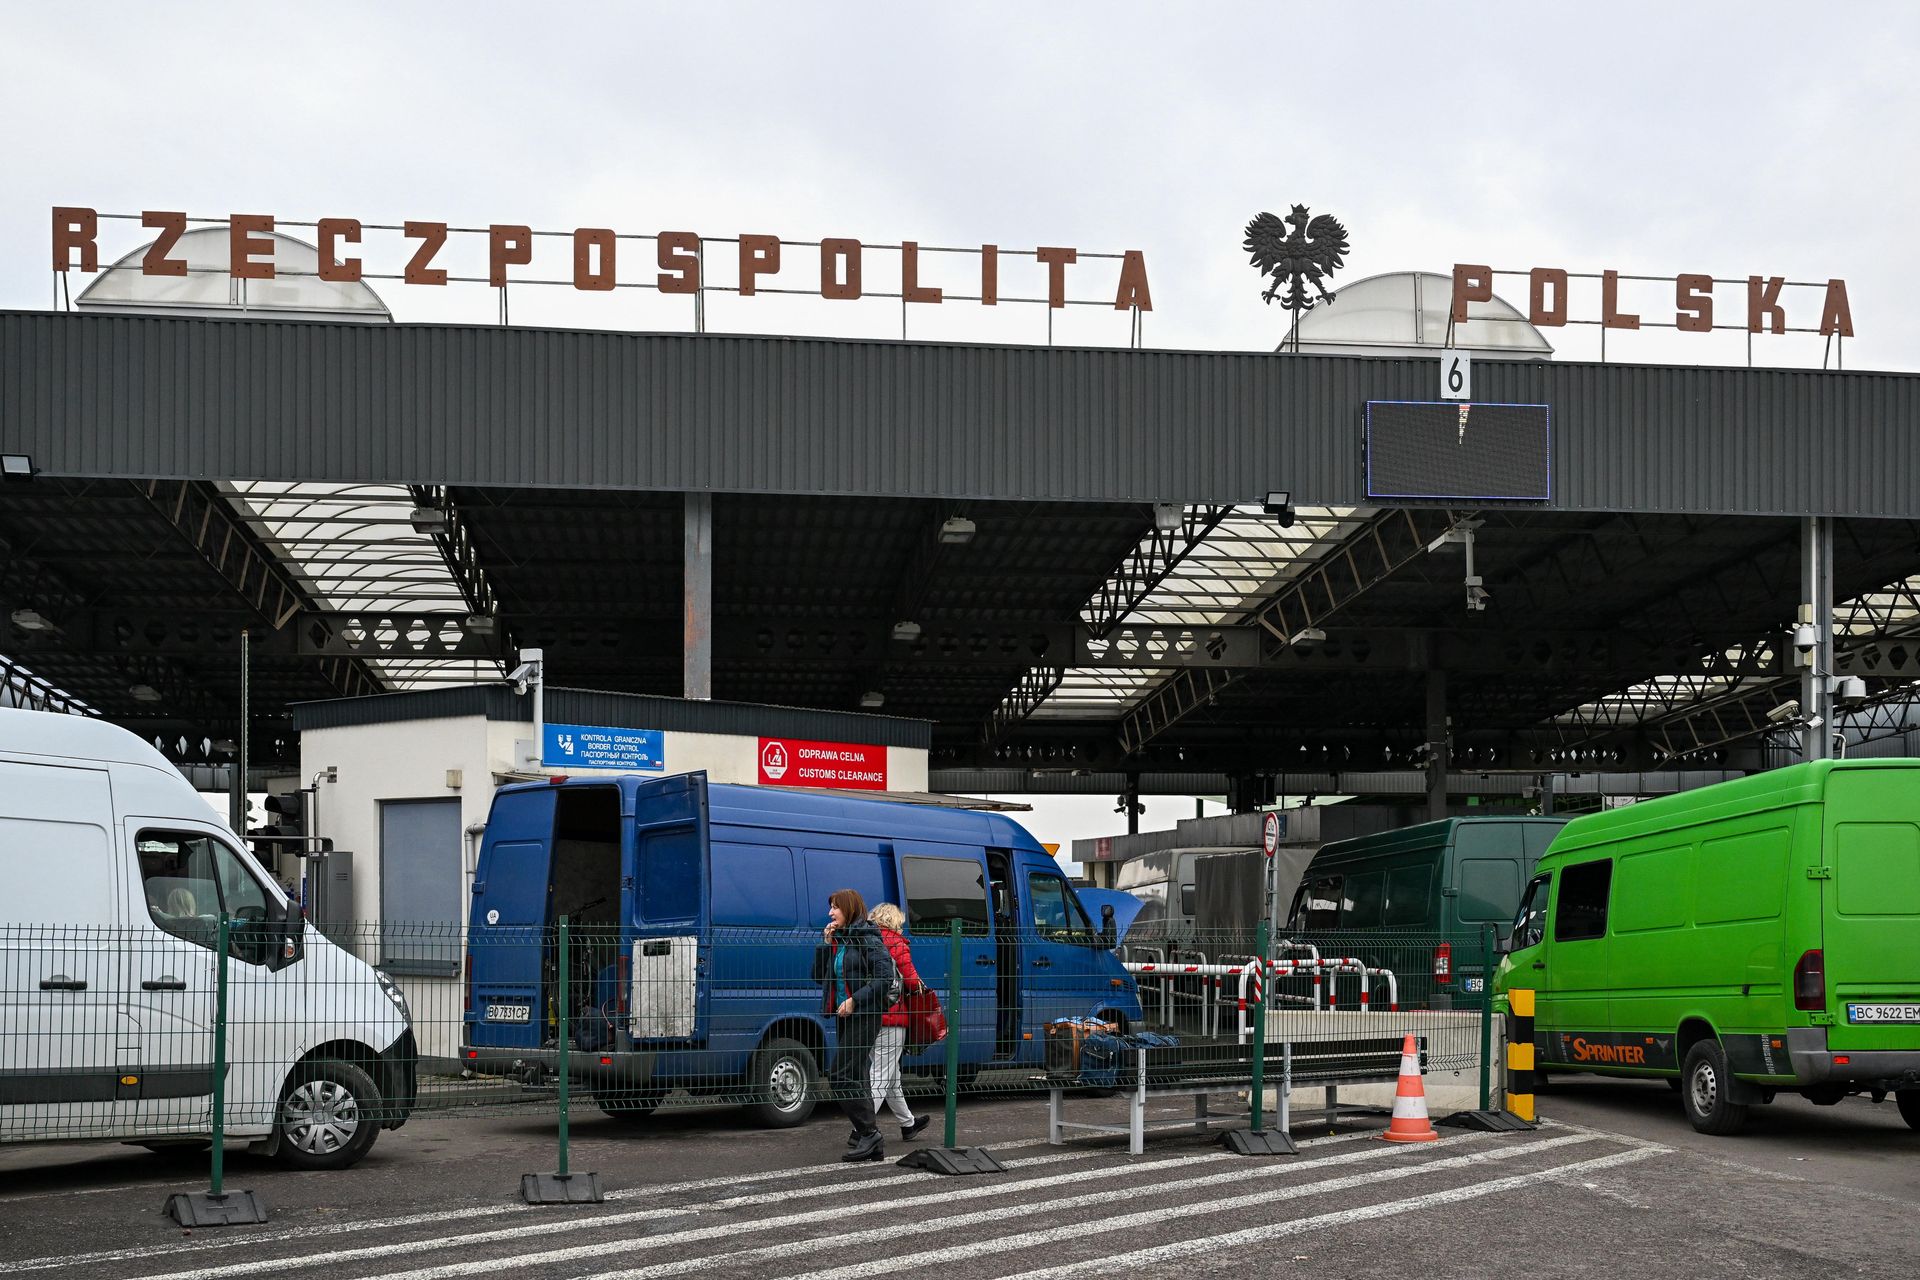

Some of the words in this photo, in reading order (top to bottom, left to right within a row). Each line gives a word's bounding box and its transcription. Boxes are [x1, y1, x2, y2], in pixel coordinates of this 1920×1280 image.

[52, 206, 1153, 312] RZECZPOSPOLITA
[1453, 263, 1855, 337] POLSKA
[1448, 356, 1463, 393] 6
[581, 734, 611, 742] KONTROLA
[614, 736, 647, 744] GRANICZNA
[581, 751, 619, 759] ПАСПОРТНЫЙ
[621, 752, 648, 760] КОНТРОЛЬ
[799, 749, 838, 760] ODPRAWA
[840, 751, 865, 762] CELNA
[798, 767, 836, 779] CUSTOMS
[838, 769, 883, 782] CLEARANCE
[1856, 1007, 1873, 1019] BC
[1876, 1007, 1903, 1019] 9622
[1573, 1037, 1646, 1065] SPRINTER
